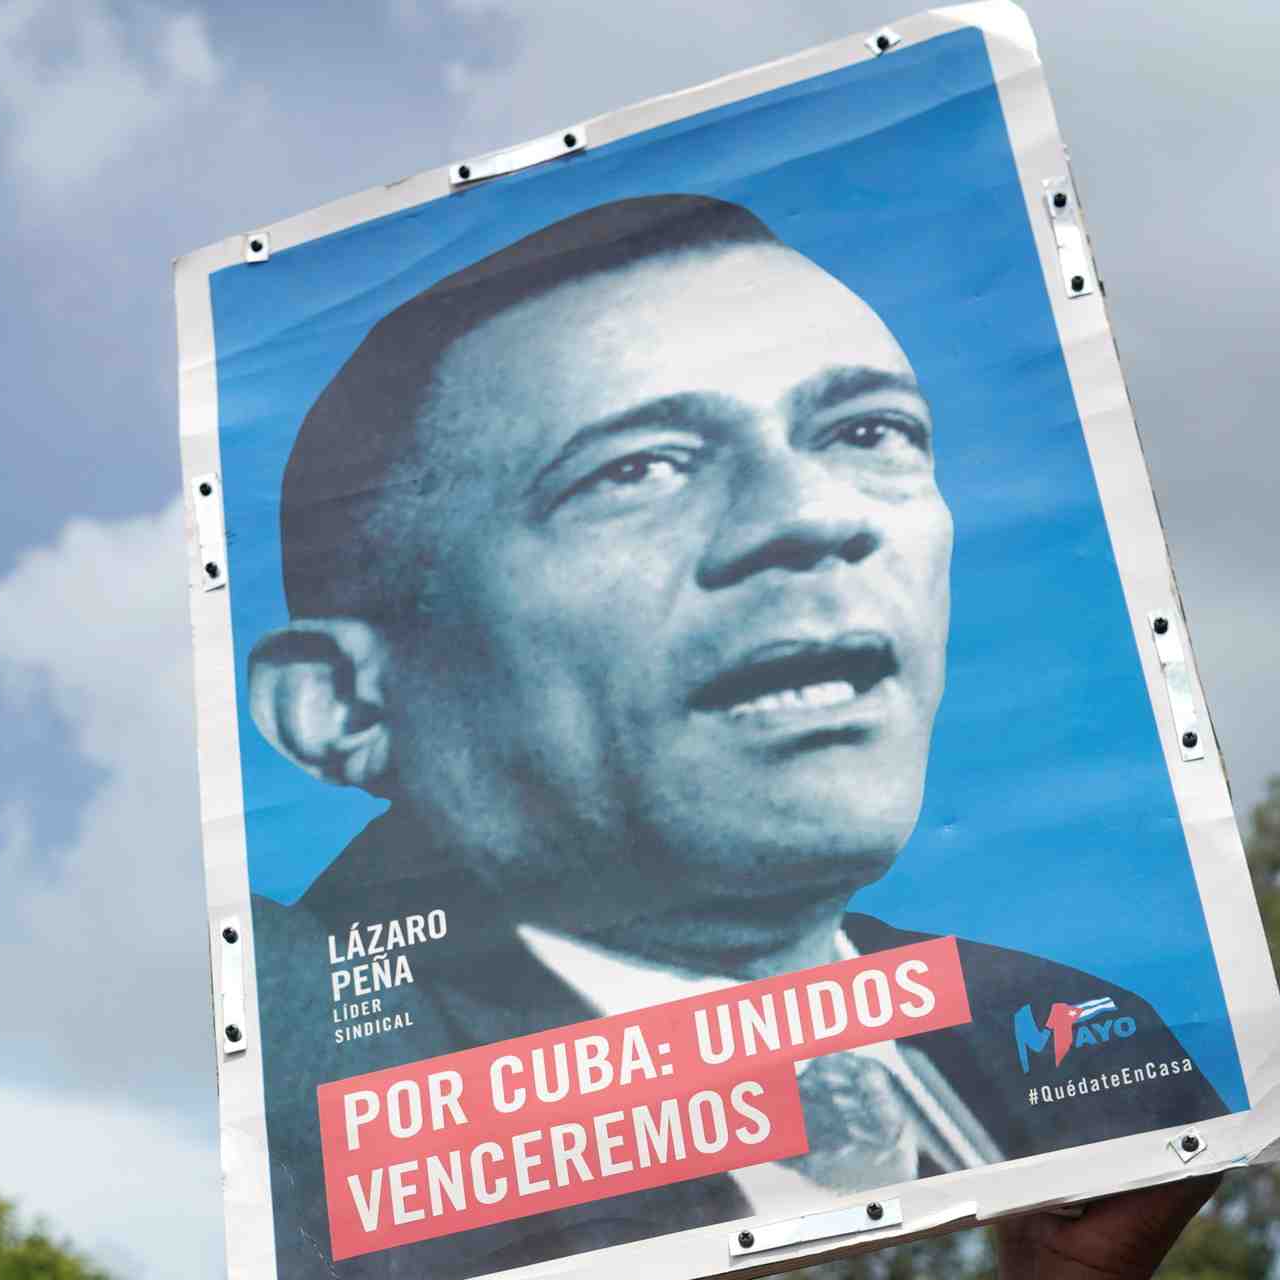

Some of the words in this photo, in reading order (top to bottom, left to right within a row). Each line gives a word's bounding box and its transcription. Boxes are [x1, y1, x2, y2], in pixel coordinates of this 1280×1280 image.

[328, 909, 447, 964] LÁZARO
[331, 953, 414, 1002] PEÑA
[333, 999, 382, 1023] LÍDER
[335, 1012, 414, 1044] SINDICAL
[343, 1070, 469, 1151] POR
[489, 1025, 674, 1112] CUBA:
[694, 959, 936, 1064] UNIDOS
[1028, 1057, 1193, 1104] #QuédateEnCasa
[347, 1080, 772, 1233] VENCEREMOS
